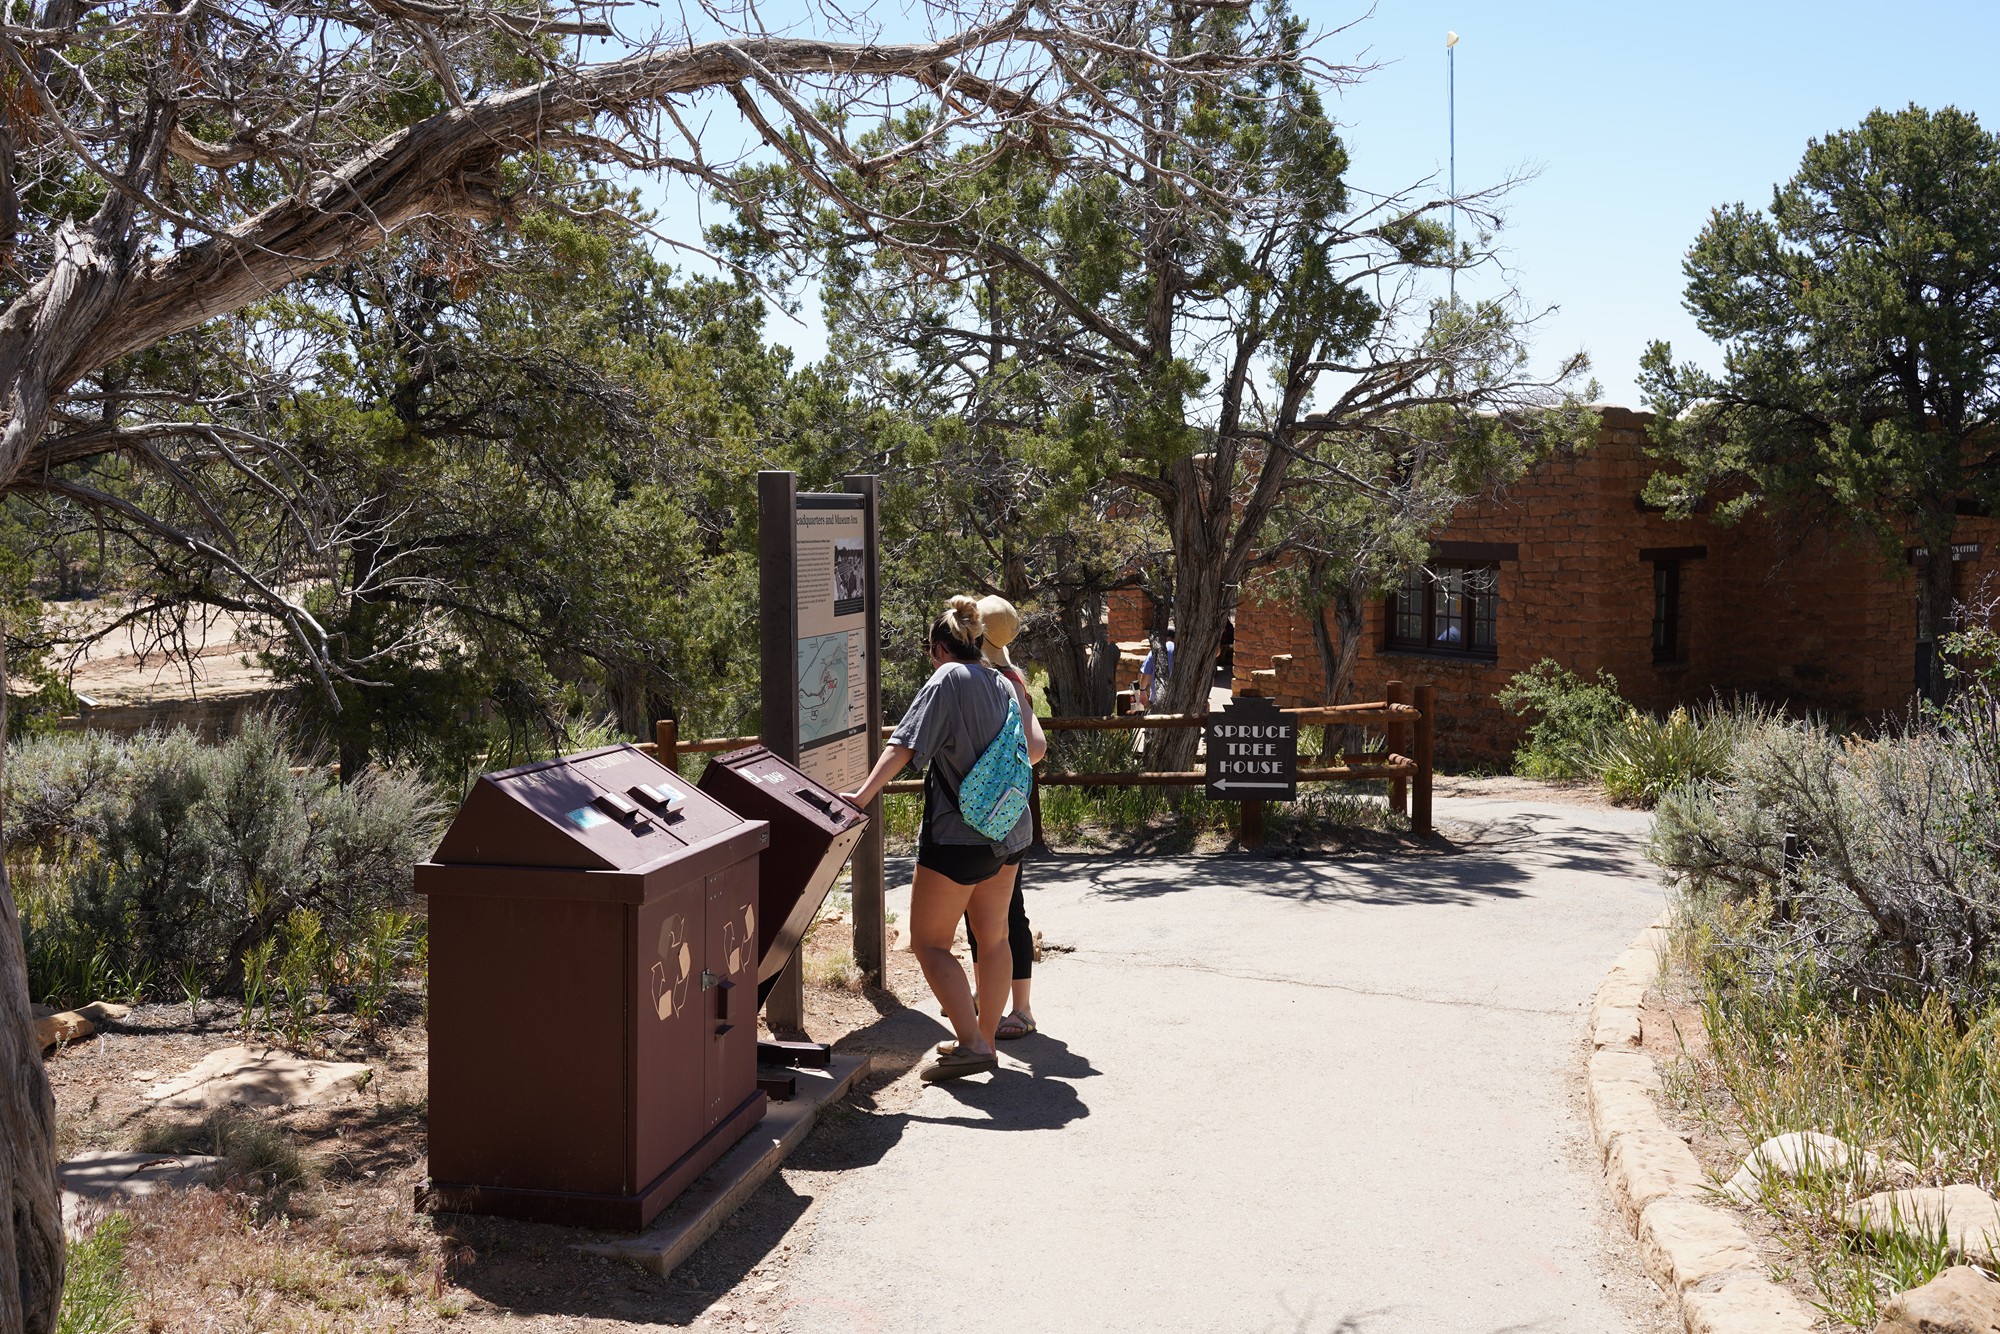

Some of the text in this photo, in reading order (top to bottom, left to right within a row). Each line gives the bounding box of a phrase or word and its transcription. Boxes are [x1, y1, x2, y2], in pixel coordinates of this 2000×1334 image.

[796, 514, 825, 528] eadquarters
[826, 514, 834, 525] and
[1213, 725, 1291, 738] SPRUCE
[1226, 743, 1277, 756] TREE
[1219, 760, 1283, 774] HOUSE
[507, 769, 562, 789] PLASTIC
[761, 770, 788, 785] TRASH
